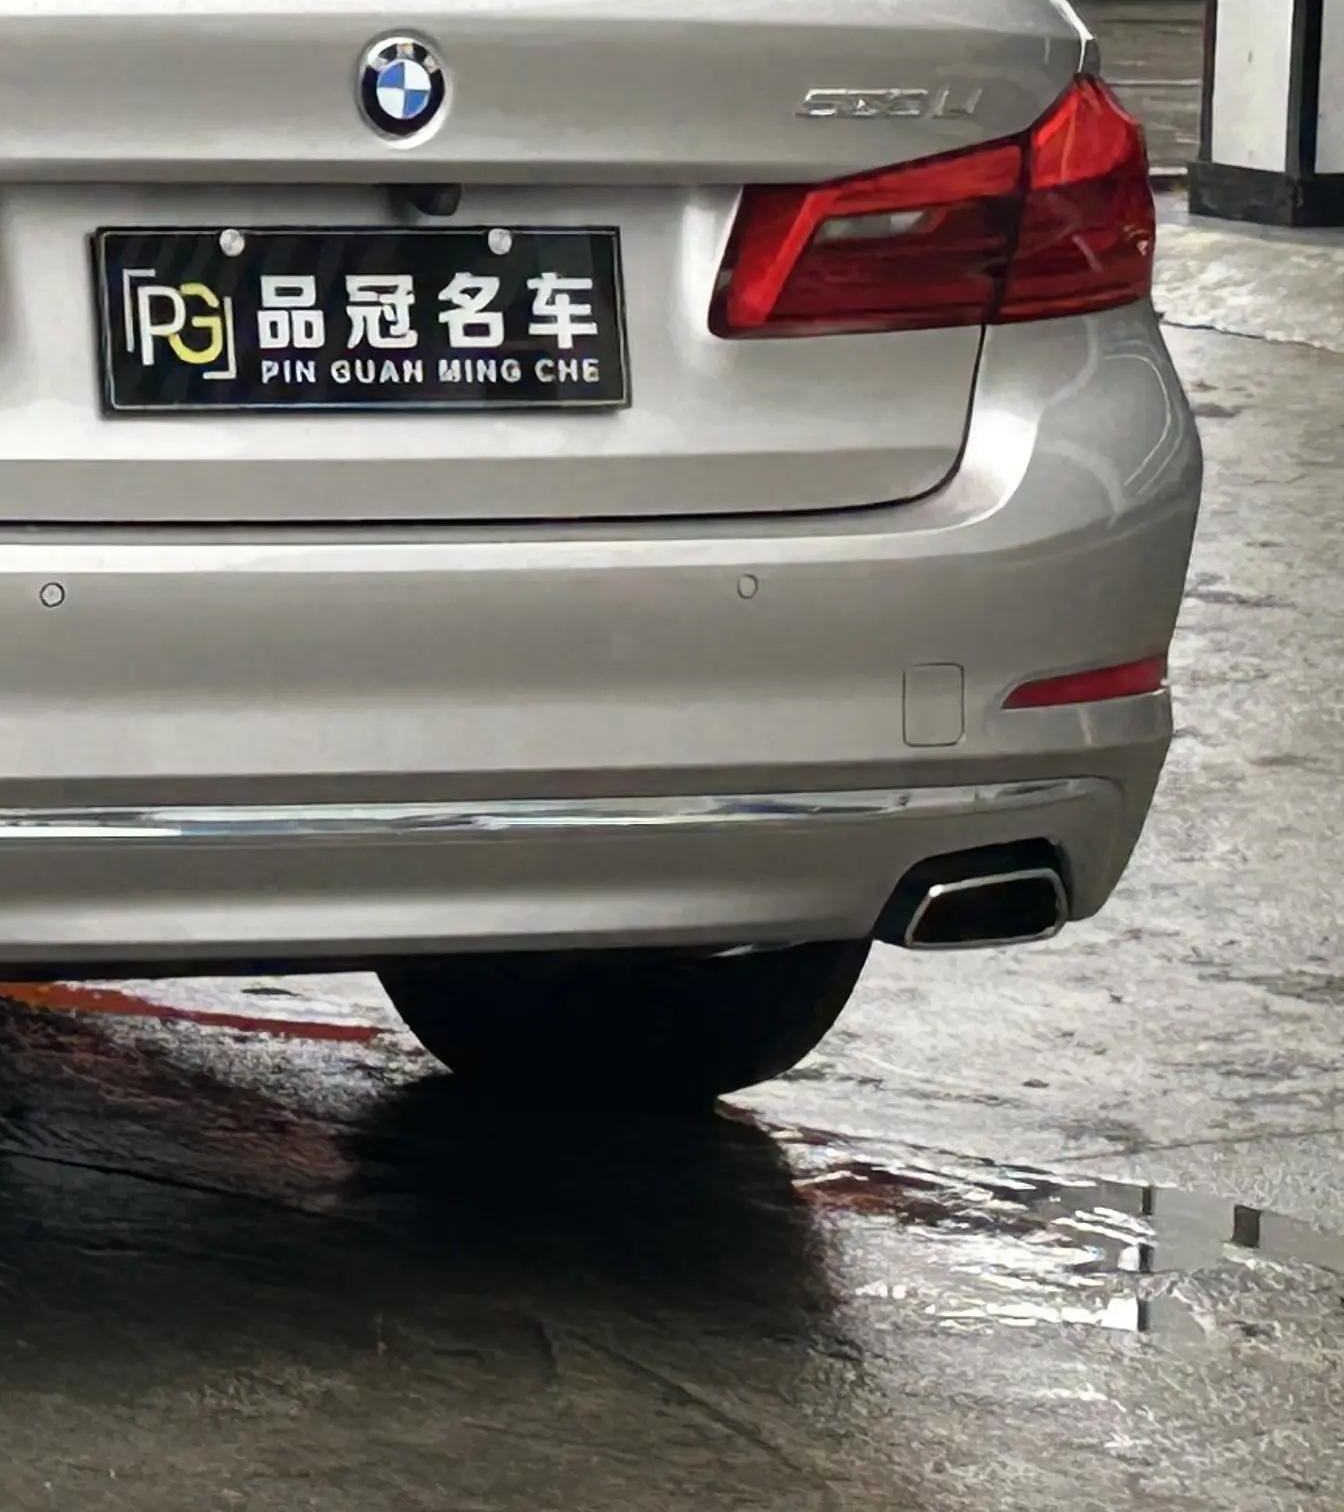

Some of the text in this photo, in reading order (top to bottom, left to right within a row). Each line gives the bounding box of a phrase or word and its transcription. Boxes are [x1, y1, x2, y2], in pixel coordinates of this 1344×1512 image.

[257, 272, 599, 350] 品冠名车
[261, 357, 600, 385] PIN GUAN MING CHE
